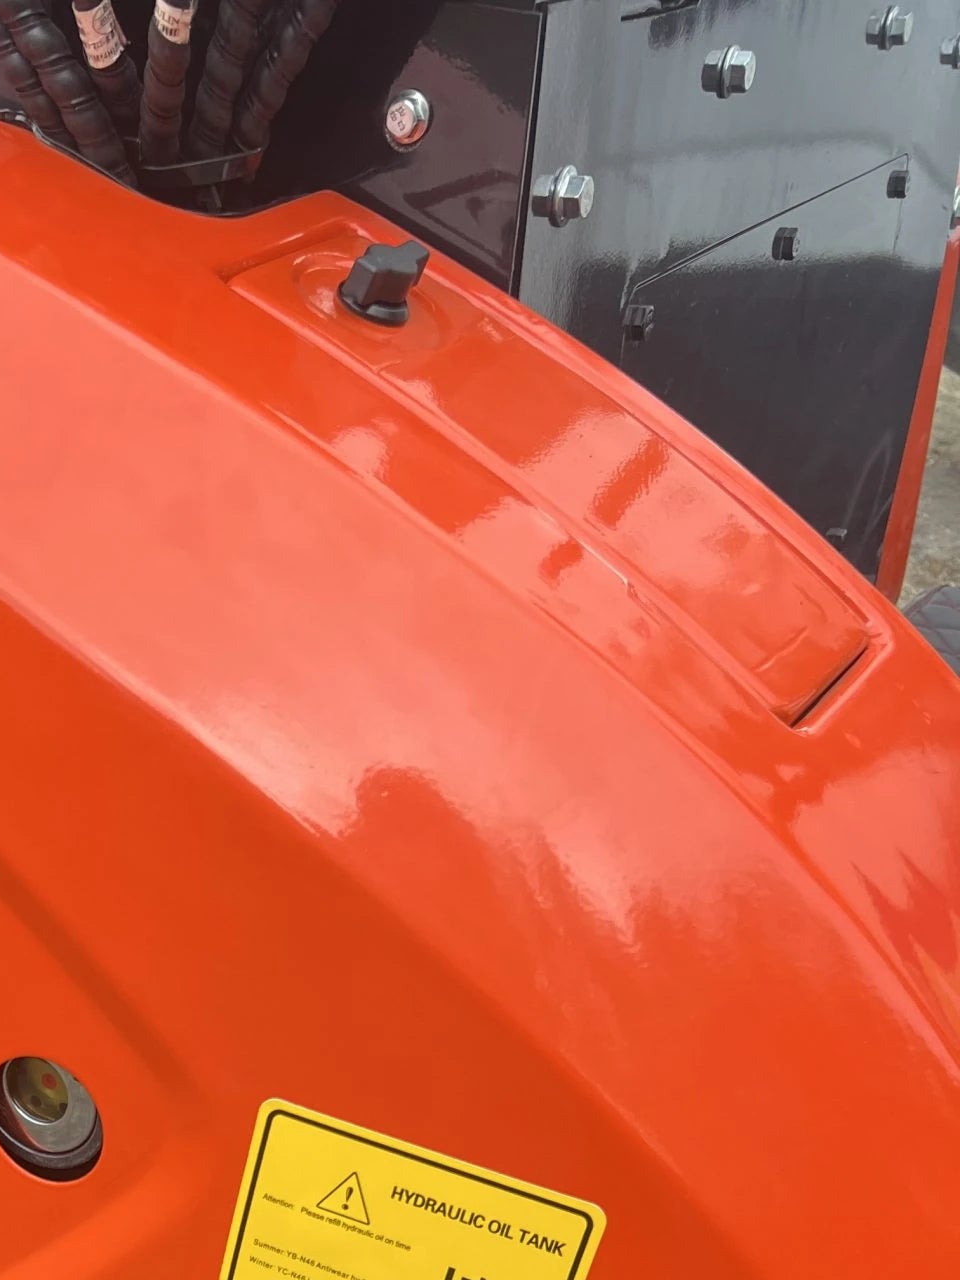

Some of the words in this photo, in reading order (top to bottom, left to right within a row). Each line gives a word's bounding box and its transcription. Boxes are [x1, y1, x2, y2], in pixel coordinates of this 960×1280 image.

[300, 1206, 324, 1221] Please
[341, 1221, 374, 1238] hydraulic
[375, 1234, 384, 1242] oil
[384, 1238, 394, 1246] on
[395, 1240, 411, 1252] time
[391, 1186, 485, 1229] HYDRAULIC
[488, 1220, 514, 1240] OIL
[519, 1229, 567, 1257] TANK
